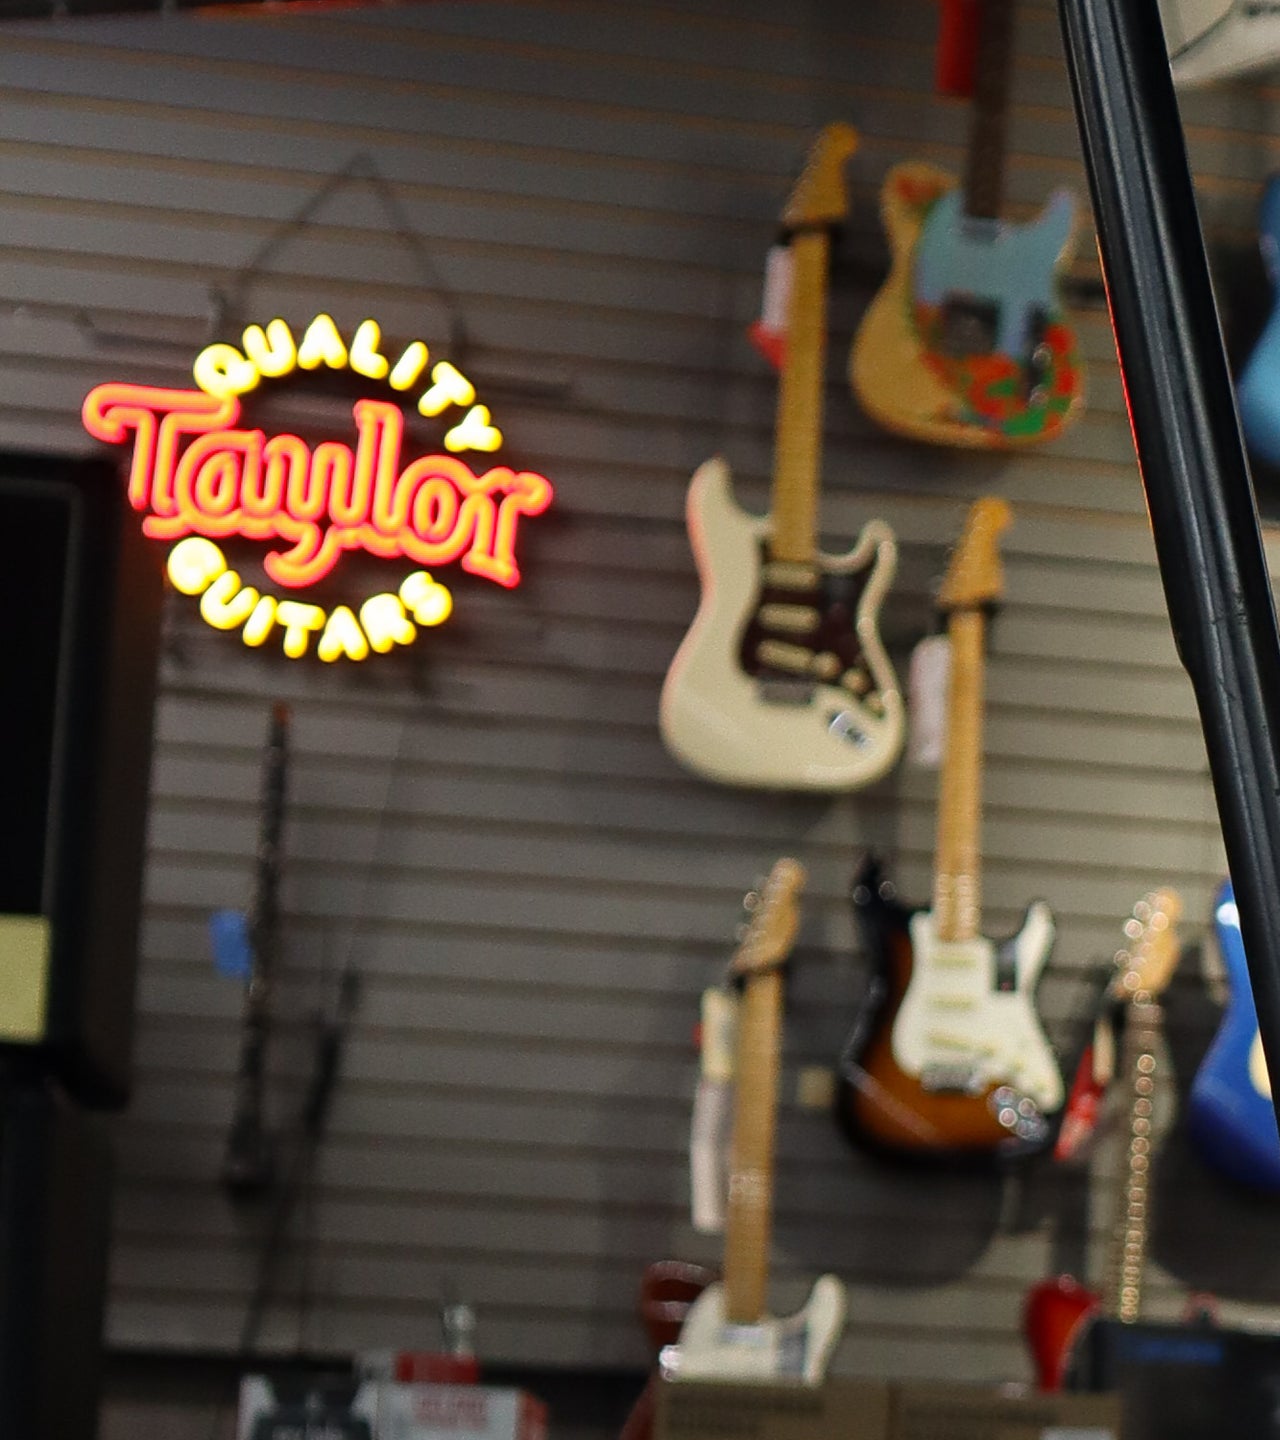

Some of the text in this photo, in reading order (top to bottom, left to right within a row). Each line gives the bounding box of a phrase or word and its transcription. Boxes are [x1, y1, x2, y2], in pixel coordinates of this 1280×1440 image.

[193, 313, 503, 453] QUALITY
[81, 382, 554, 588] Taylor
[166, 536, 454, 662] GUITARS
